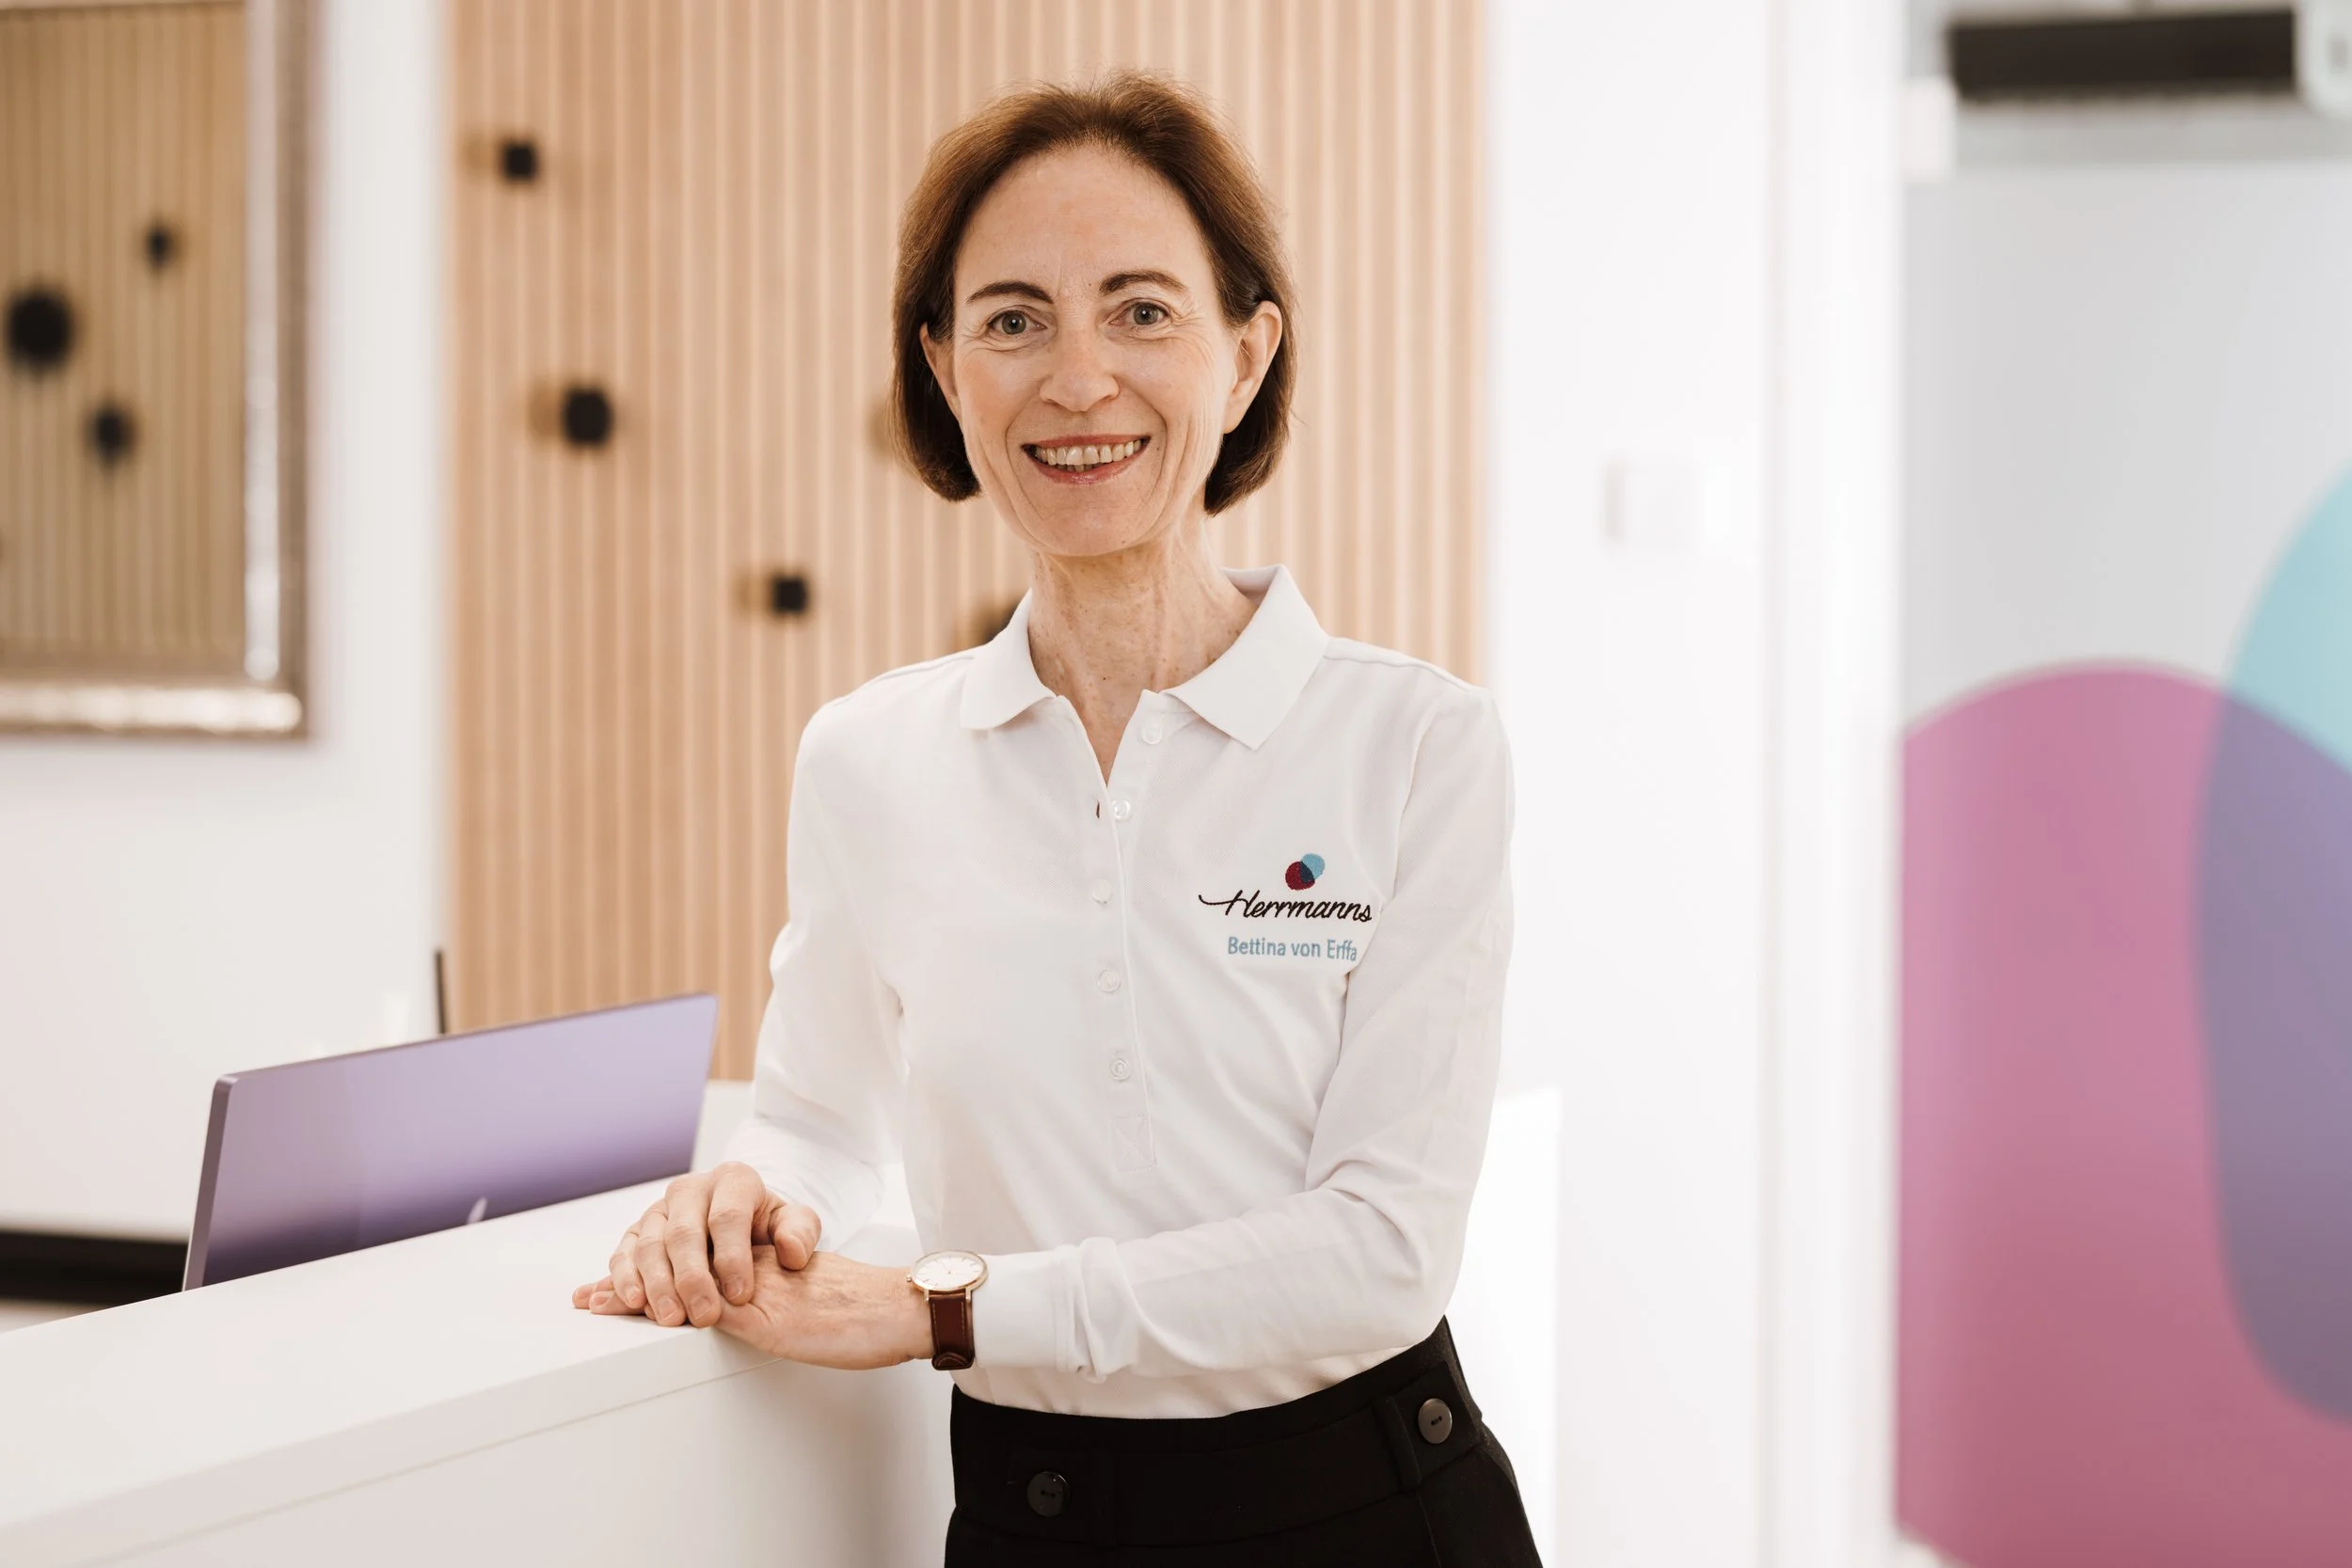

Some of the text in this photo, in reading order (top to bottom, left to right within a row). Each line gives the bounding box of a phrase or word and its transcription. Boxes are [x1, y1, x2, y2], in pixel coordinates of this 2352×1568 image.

[1198, 889, 1373, 923] Herrmanns
[1227, 936, 1358, 961] Bettina von Erffa
